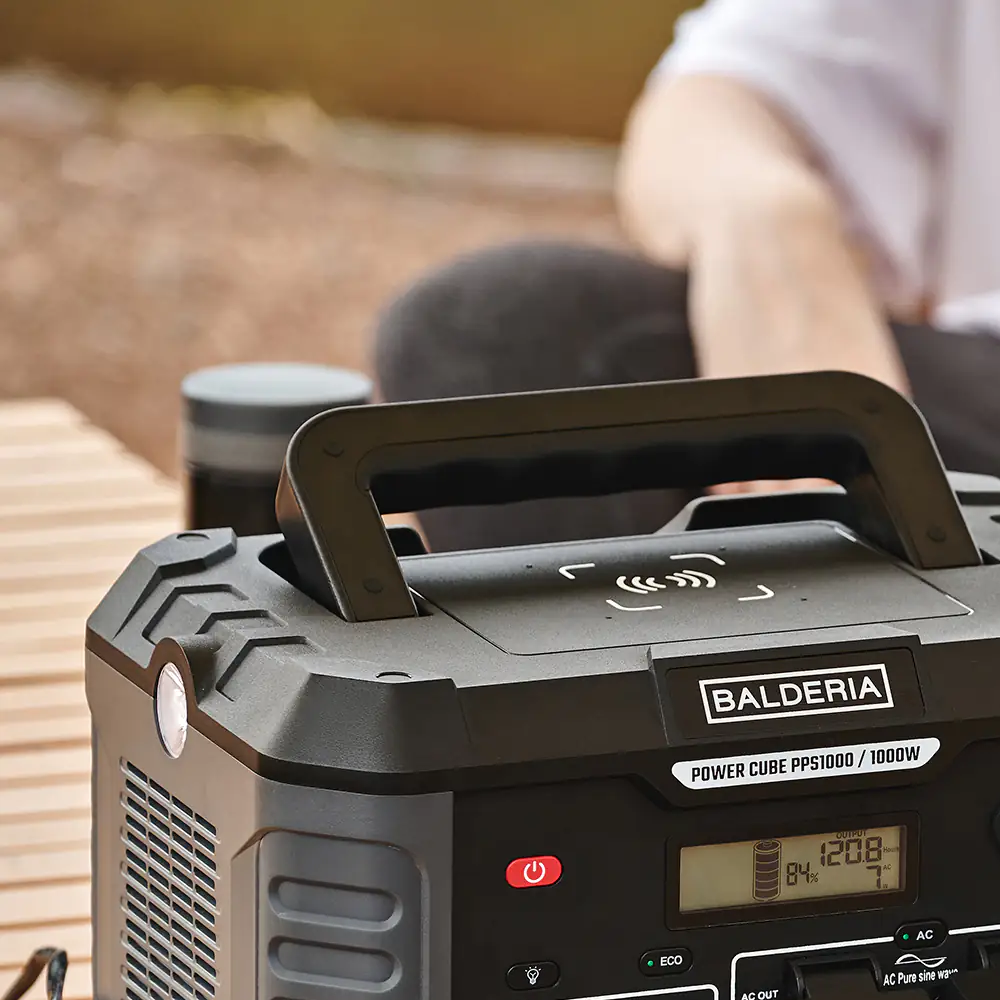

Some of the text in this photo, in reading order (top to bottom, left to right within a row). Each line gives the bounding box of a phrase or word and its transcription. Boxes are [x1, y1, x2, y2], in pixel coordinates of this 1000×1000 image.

[711, 675, 883, 713] BALDERIA
[691, 762, 746, 783] POWER
[749, 758, 787, 777] CUBE
[790, 752, 854, 773] PPS1000
[869, 745, 921, 765] 1000W
[836, 829, 867, 839] OUTPUT
[820, 836, 882, 867] 120.8
[915, 929, 934, 941] AC
[659, 955, 683, 967] ECO
[883, 972, 896, 987] AC
[897, 971, 917, 985] Pure
[918, 969, 936, 983] sine
[757, 989, 779, 1000] OUT
